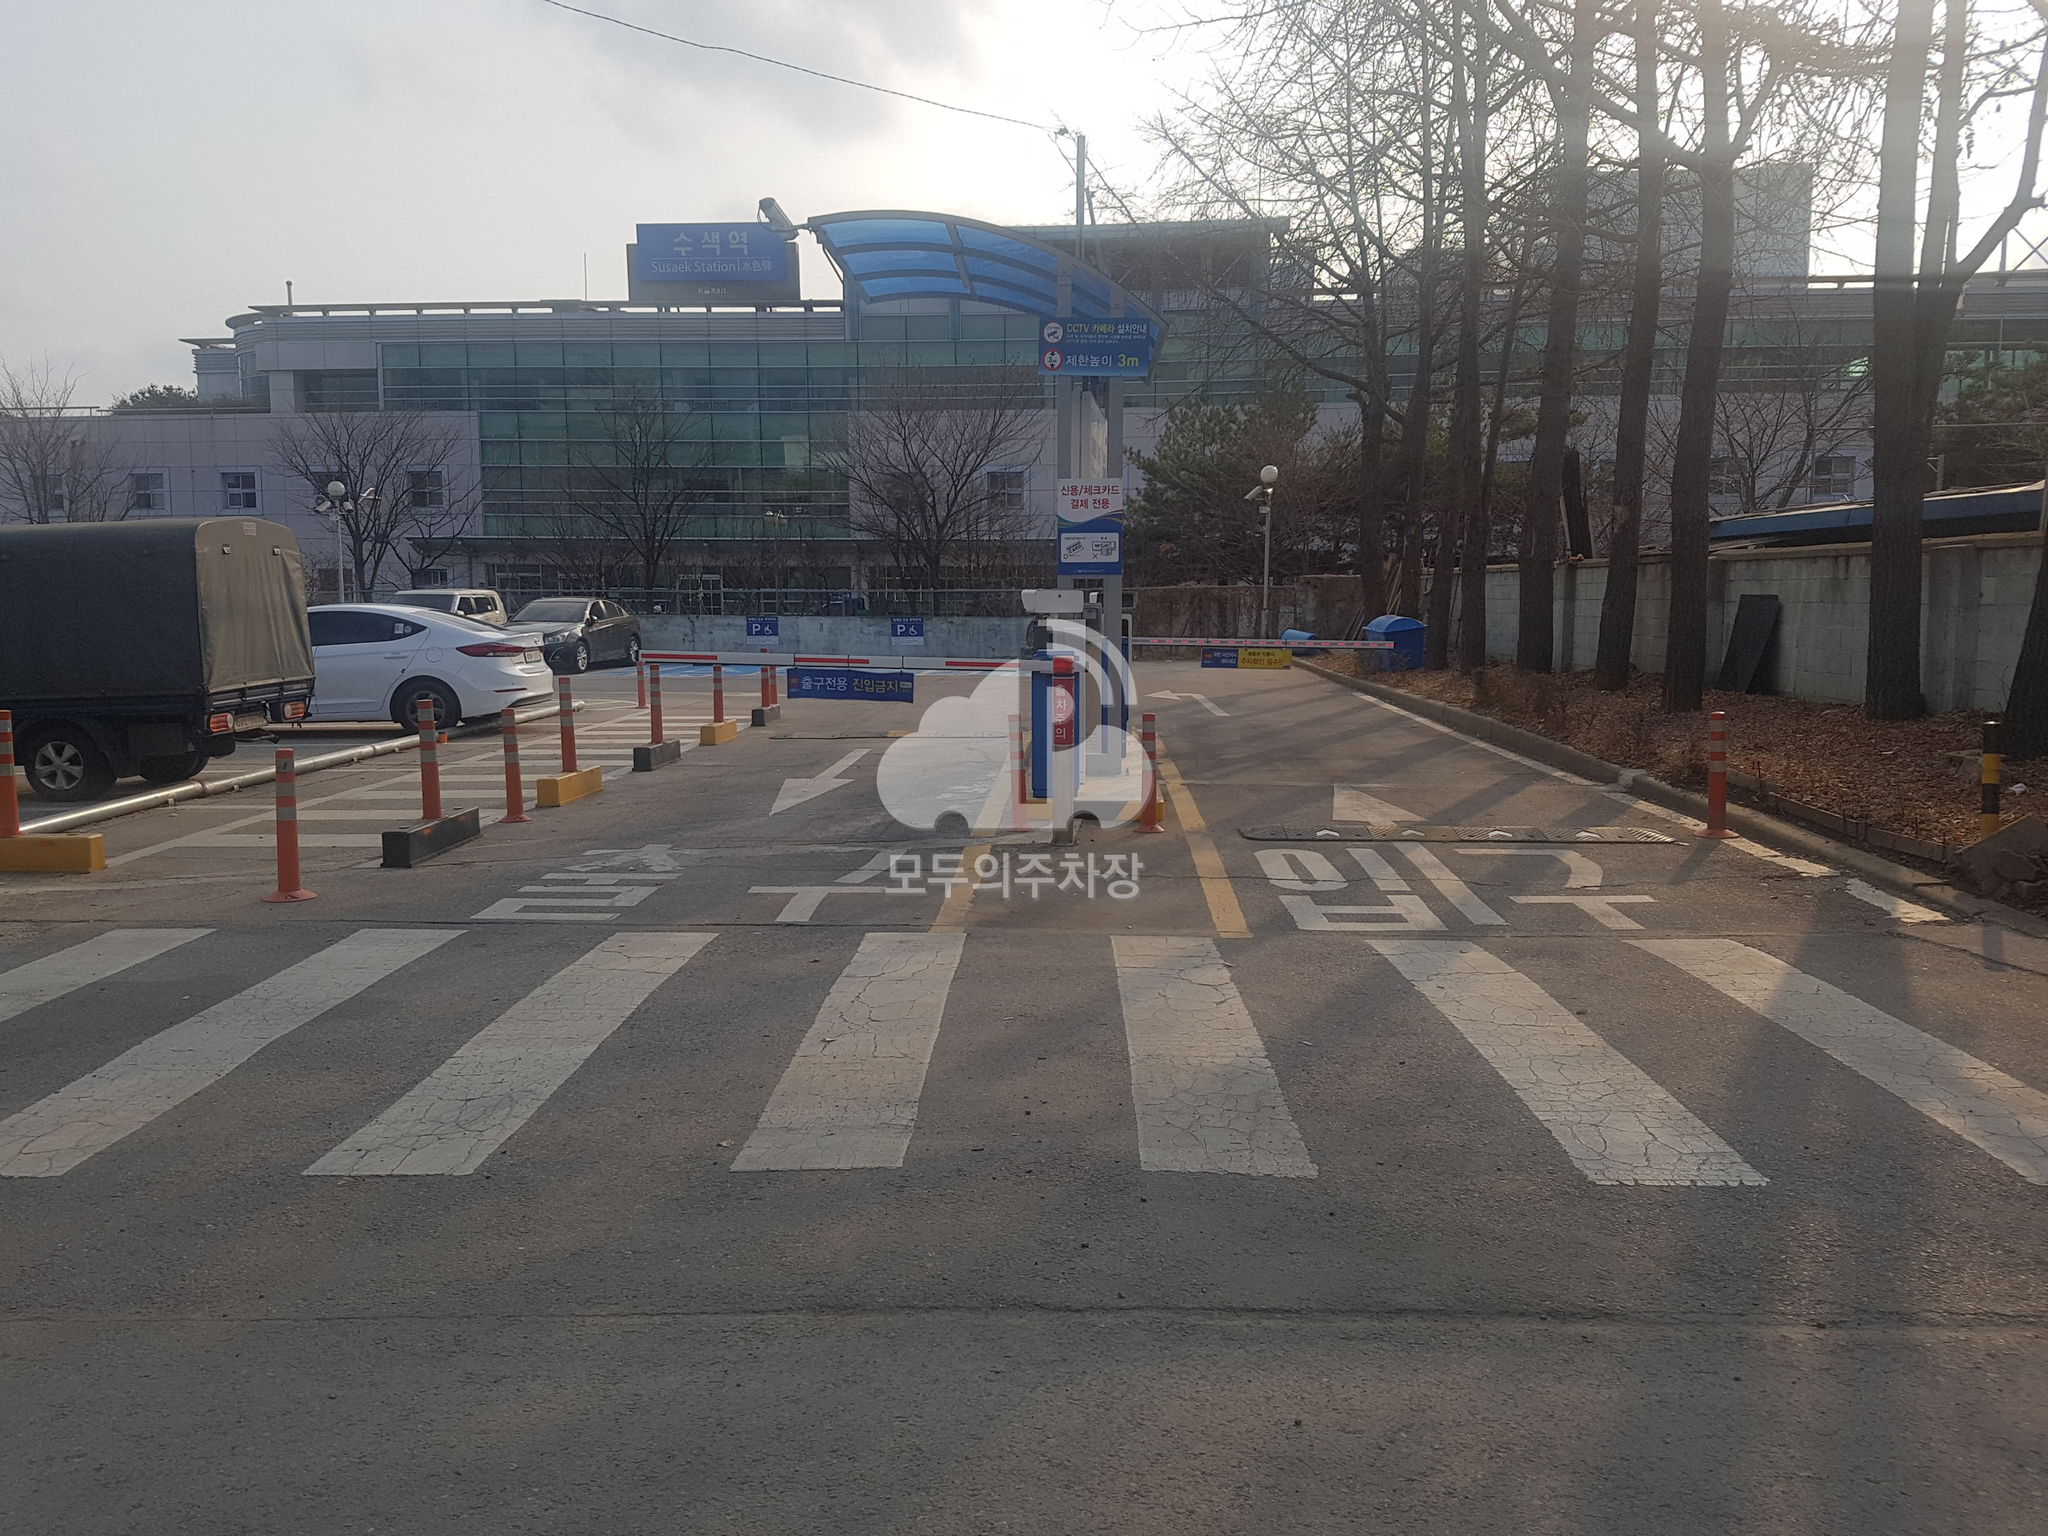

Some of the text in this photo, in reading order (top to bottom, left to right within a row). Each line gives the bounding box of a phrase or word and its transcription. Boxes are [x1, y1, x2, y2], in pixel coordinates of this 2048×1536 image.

[673, 231, 748, 257] 수색역
[651, 261, 691, 273] Susaek
[694, 260, 736, 273] Station
[1066, 323, 1090, 334] CCTV
[1092, 323, 1115, 334] 카메라
[1117, 323, 1148, 334] 설치안내
[1066, 353, 1139, 367] 제한높이 3m
[1061, 485, 1120, 496] 신용/체크카드
[1071, 499, 1110, 509] 결제 전용
[752, 623, 761, 635] P
[897, 624, 906, 636] P
[801, 676, 848, 691] 출구전용
[853, 678, 898, 693] 진입금지
